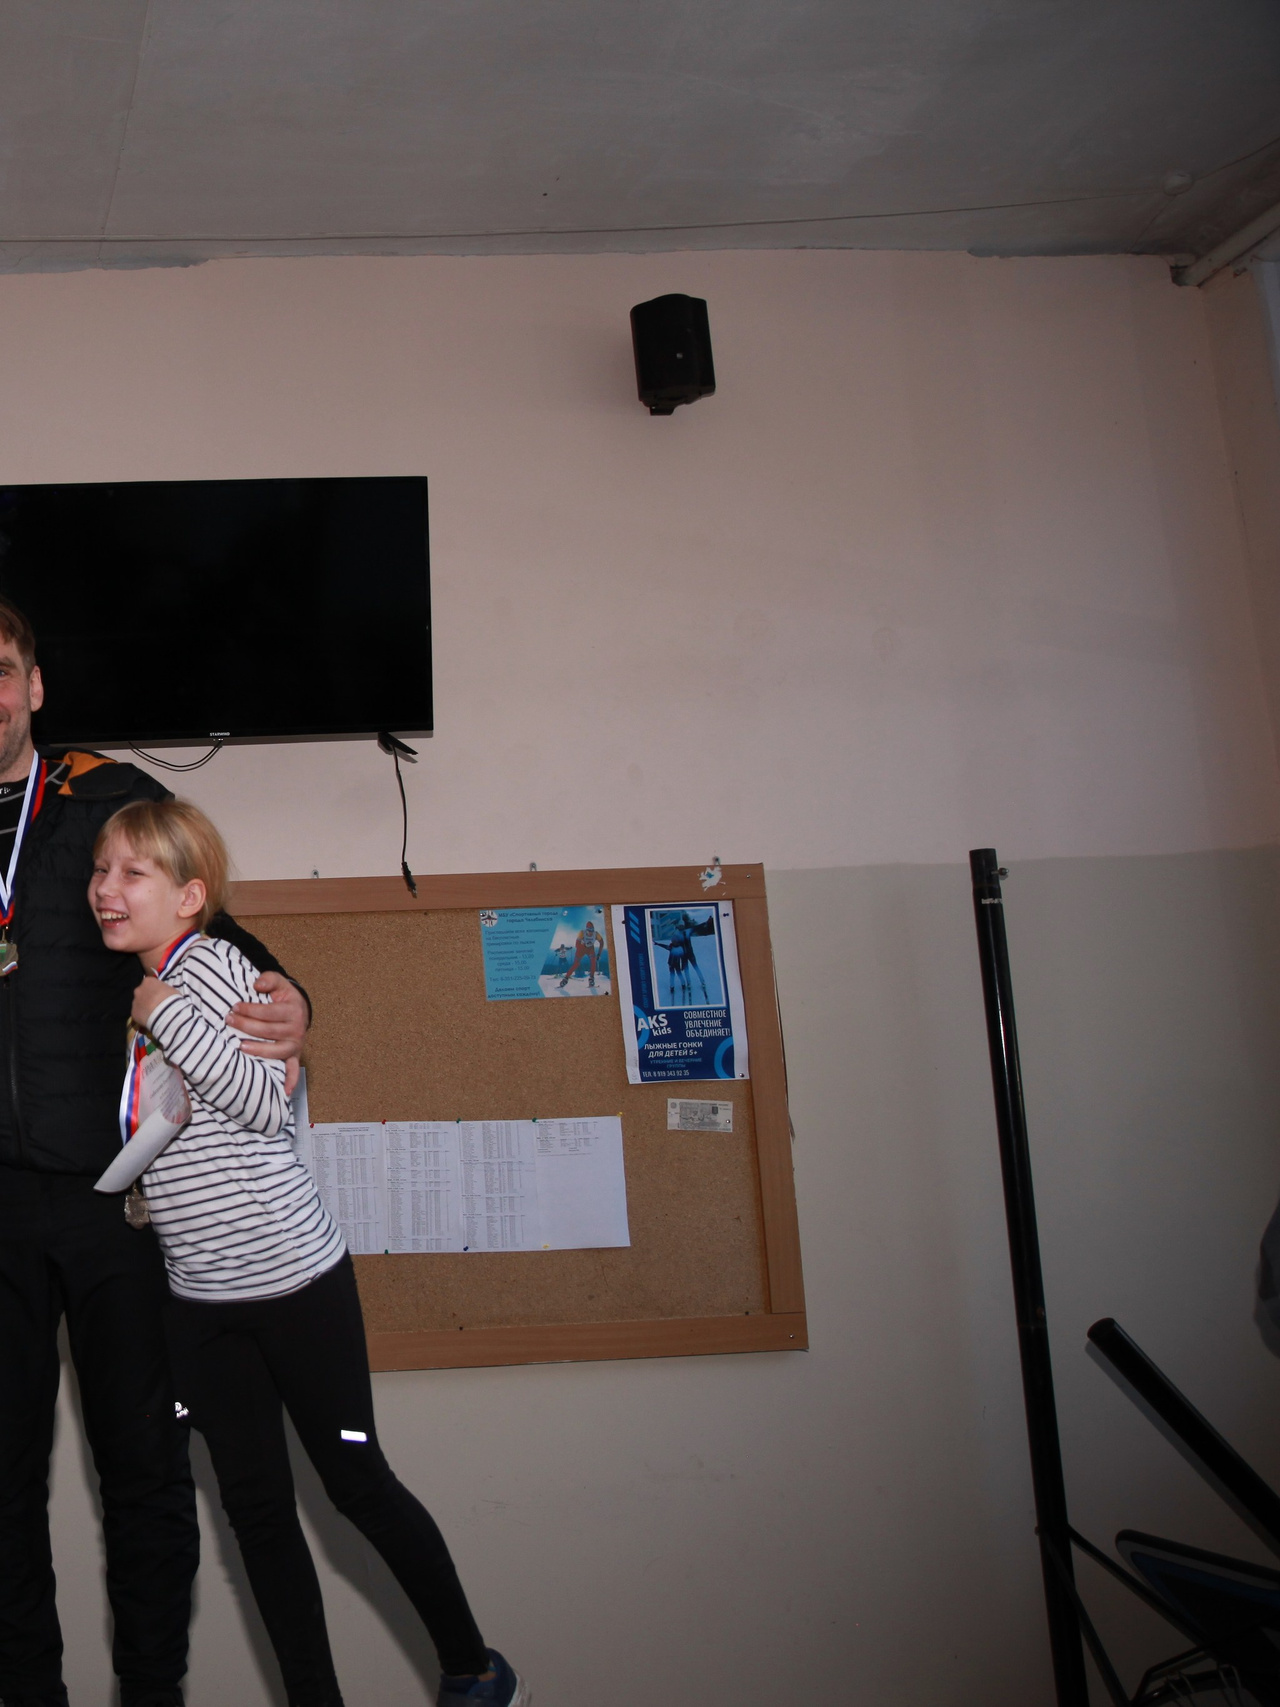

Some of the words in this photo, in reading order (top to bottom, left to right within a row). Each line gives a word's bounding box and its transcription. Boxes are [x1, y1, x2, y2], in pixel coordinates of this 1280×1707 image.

[683, 1009, 727, 1019] СОВМЕСТНОЕ
[637, 1013, 668, 1032] AKS
[684, 1019, 722, 1029] УВЛЕЧЕНИЕ
[652, 1027, 672, 1037] kids
[685, 1028, 731, 1038] ОБЪЕДИНЯЕТ!
[644, 1042, 678, 1050] ЛЫЖНЫЕ
[664, 1049, 688, 1058] ДЕТЕЙ
